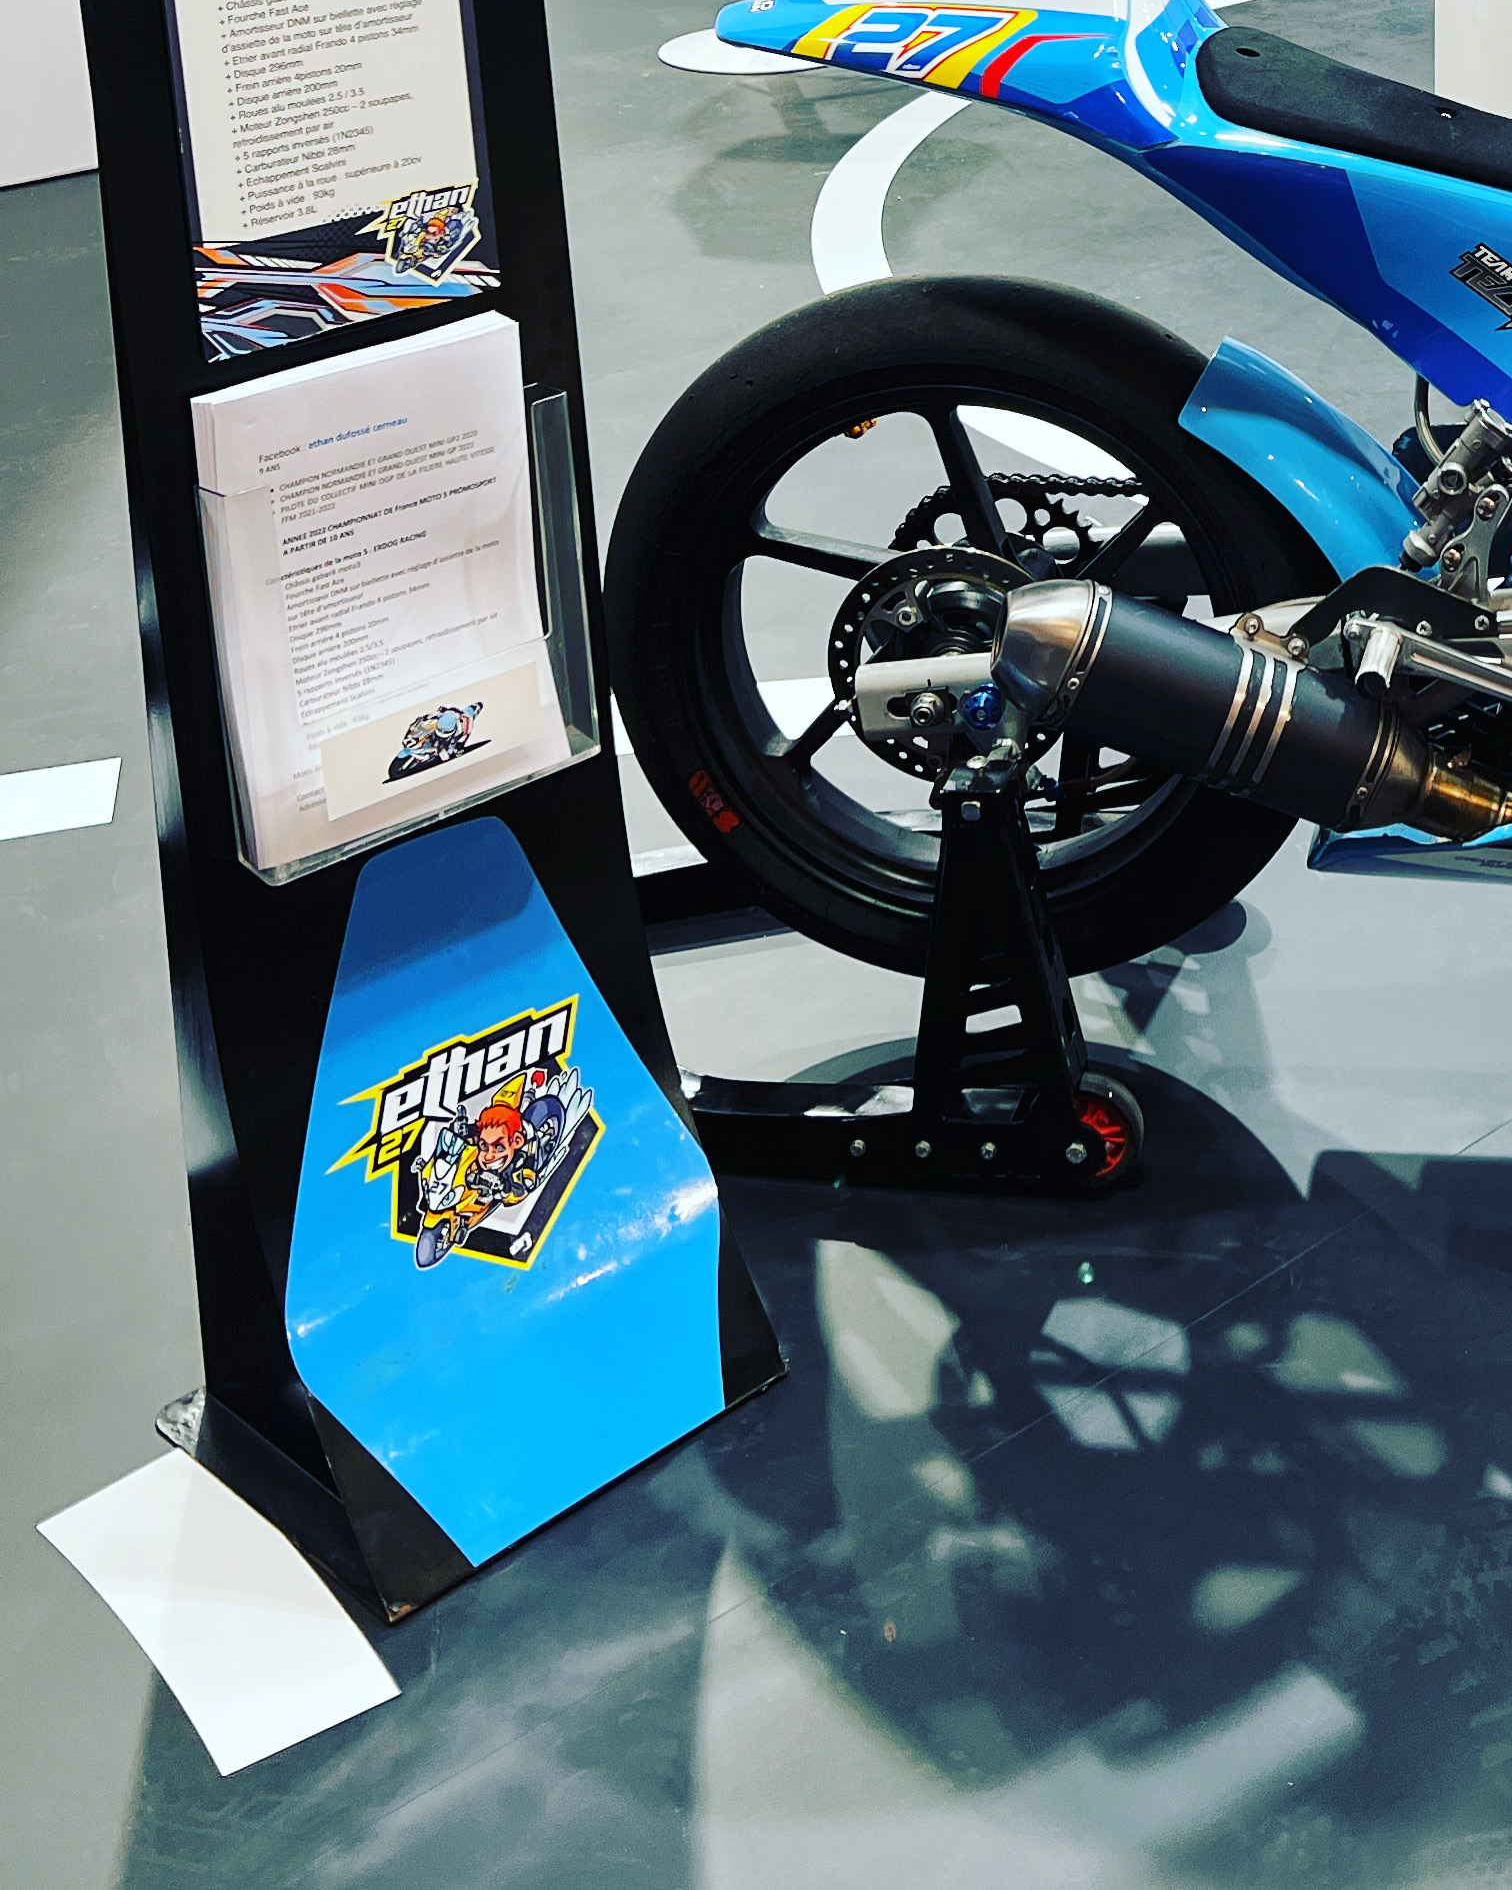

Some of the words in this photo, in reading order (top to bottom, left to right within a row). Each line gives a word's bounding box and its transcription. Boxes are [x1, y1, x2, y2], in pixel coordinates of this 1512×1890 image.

[227, 11, 266, 24] Fourche
[268, 6, 290, 17] Fast
[291, 4, 309, 14] Ace
[239, 120, 273, 134] Moteur
[274, 110, 321, 127] Zongshen
[391, 185, 470, 220] ethan
[258, 446, 301, 463] Facebook
[308, 436, 334, 450] ethan
[380, 1009, 569, 1134] ethan
[378, 1117, 426, 1165] 27
[428, 1181, 451, 1196] 27
